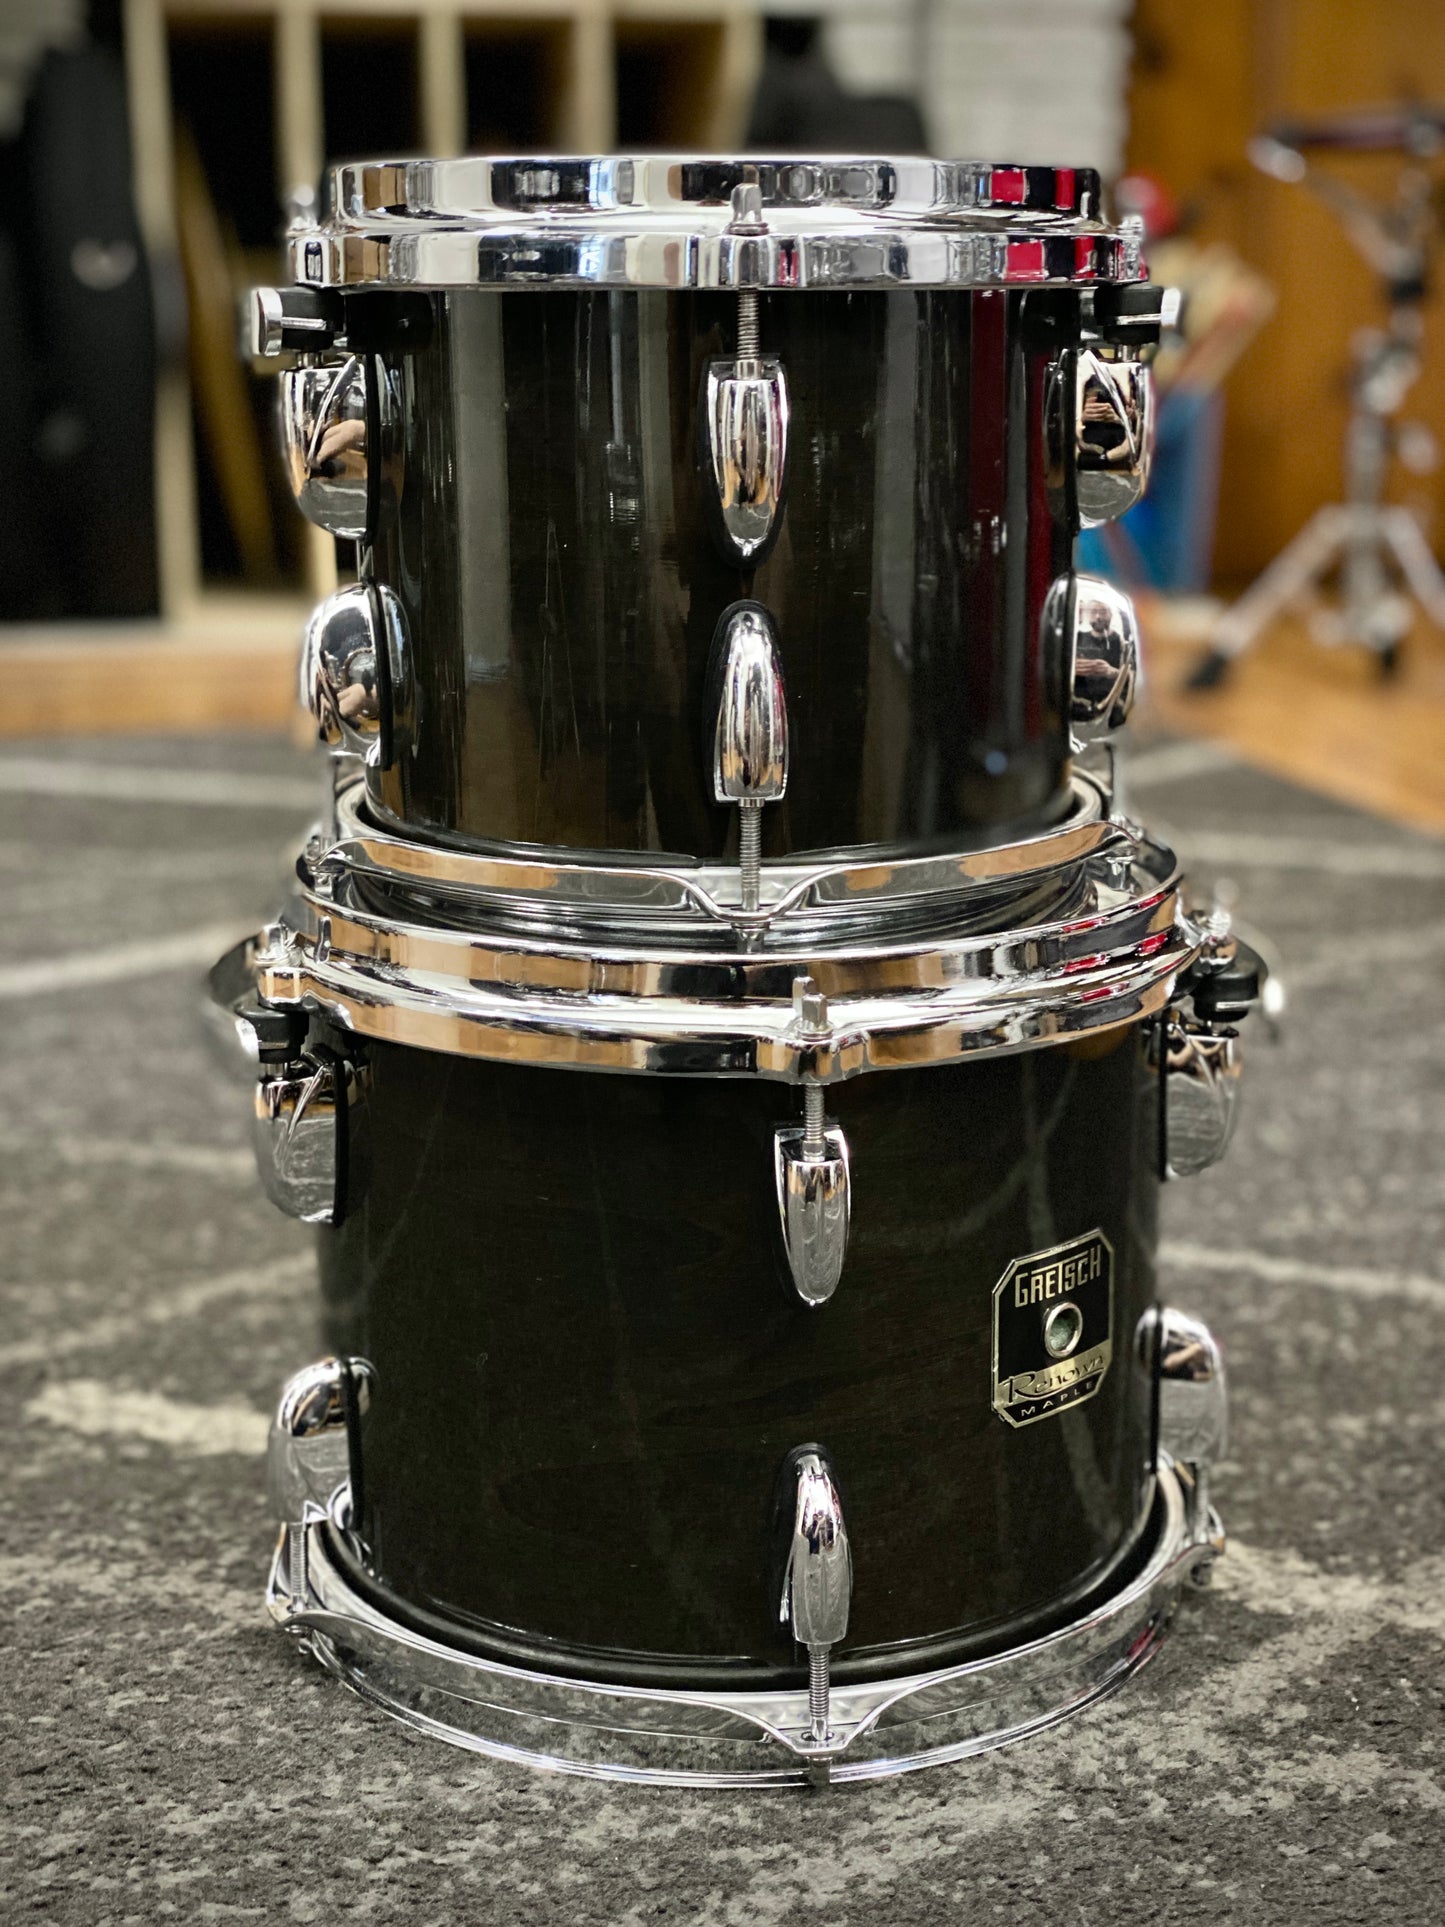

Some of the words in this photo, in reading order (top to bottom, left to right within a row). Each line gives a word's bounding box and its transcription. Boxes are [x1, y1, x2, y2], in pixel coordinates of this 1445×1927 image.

[1015, 1245, 1101, 1308] GRETSCH
[1004, 1356, 1105, 1404] Renown
[1021, 1382, 1094, 1417] MAPLE
